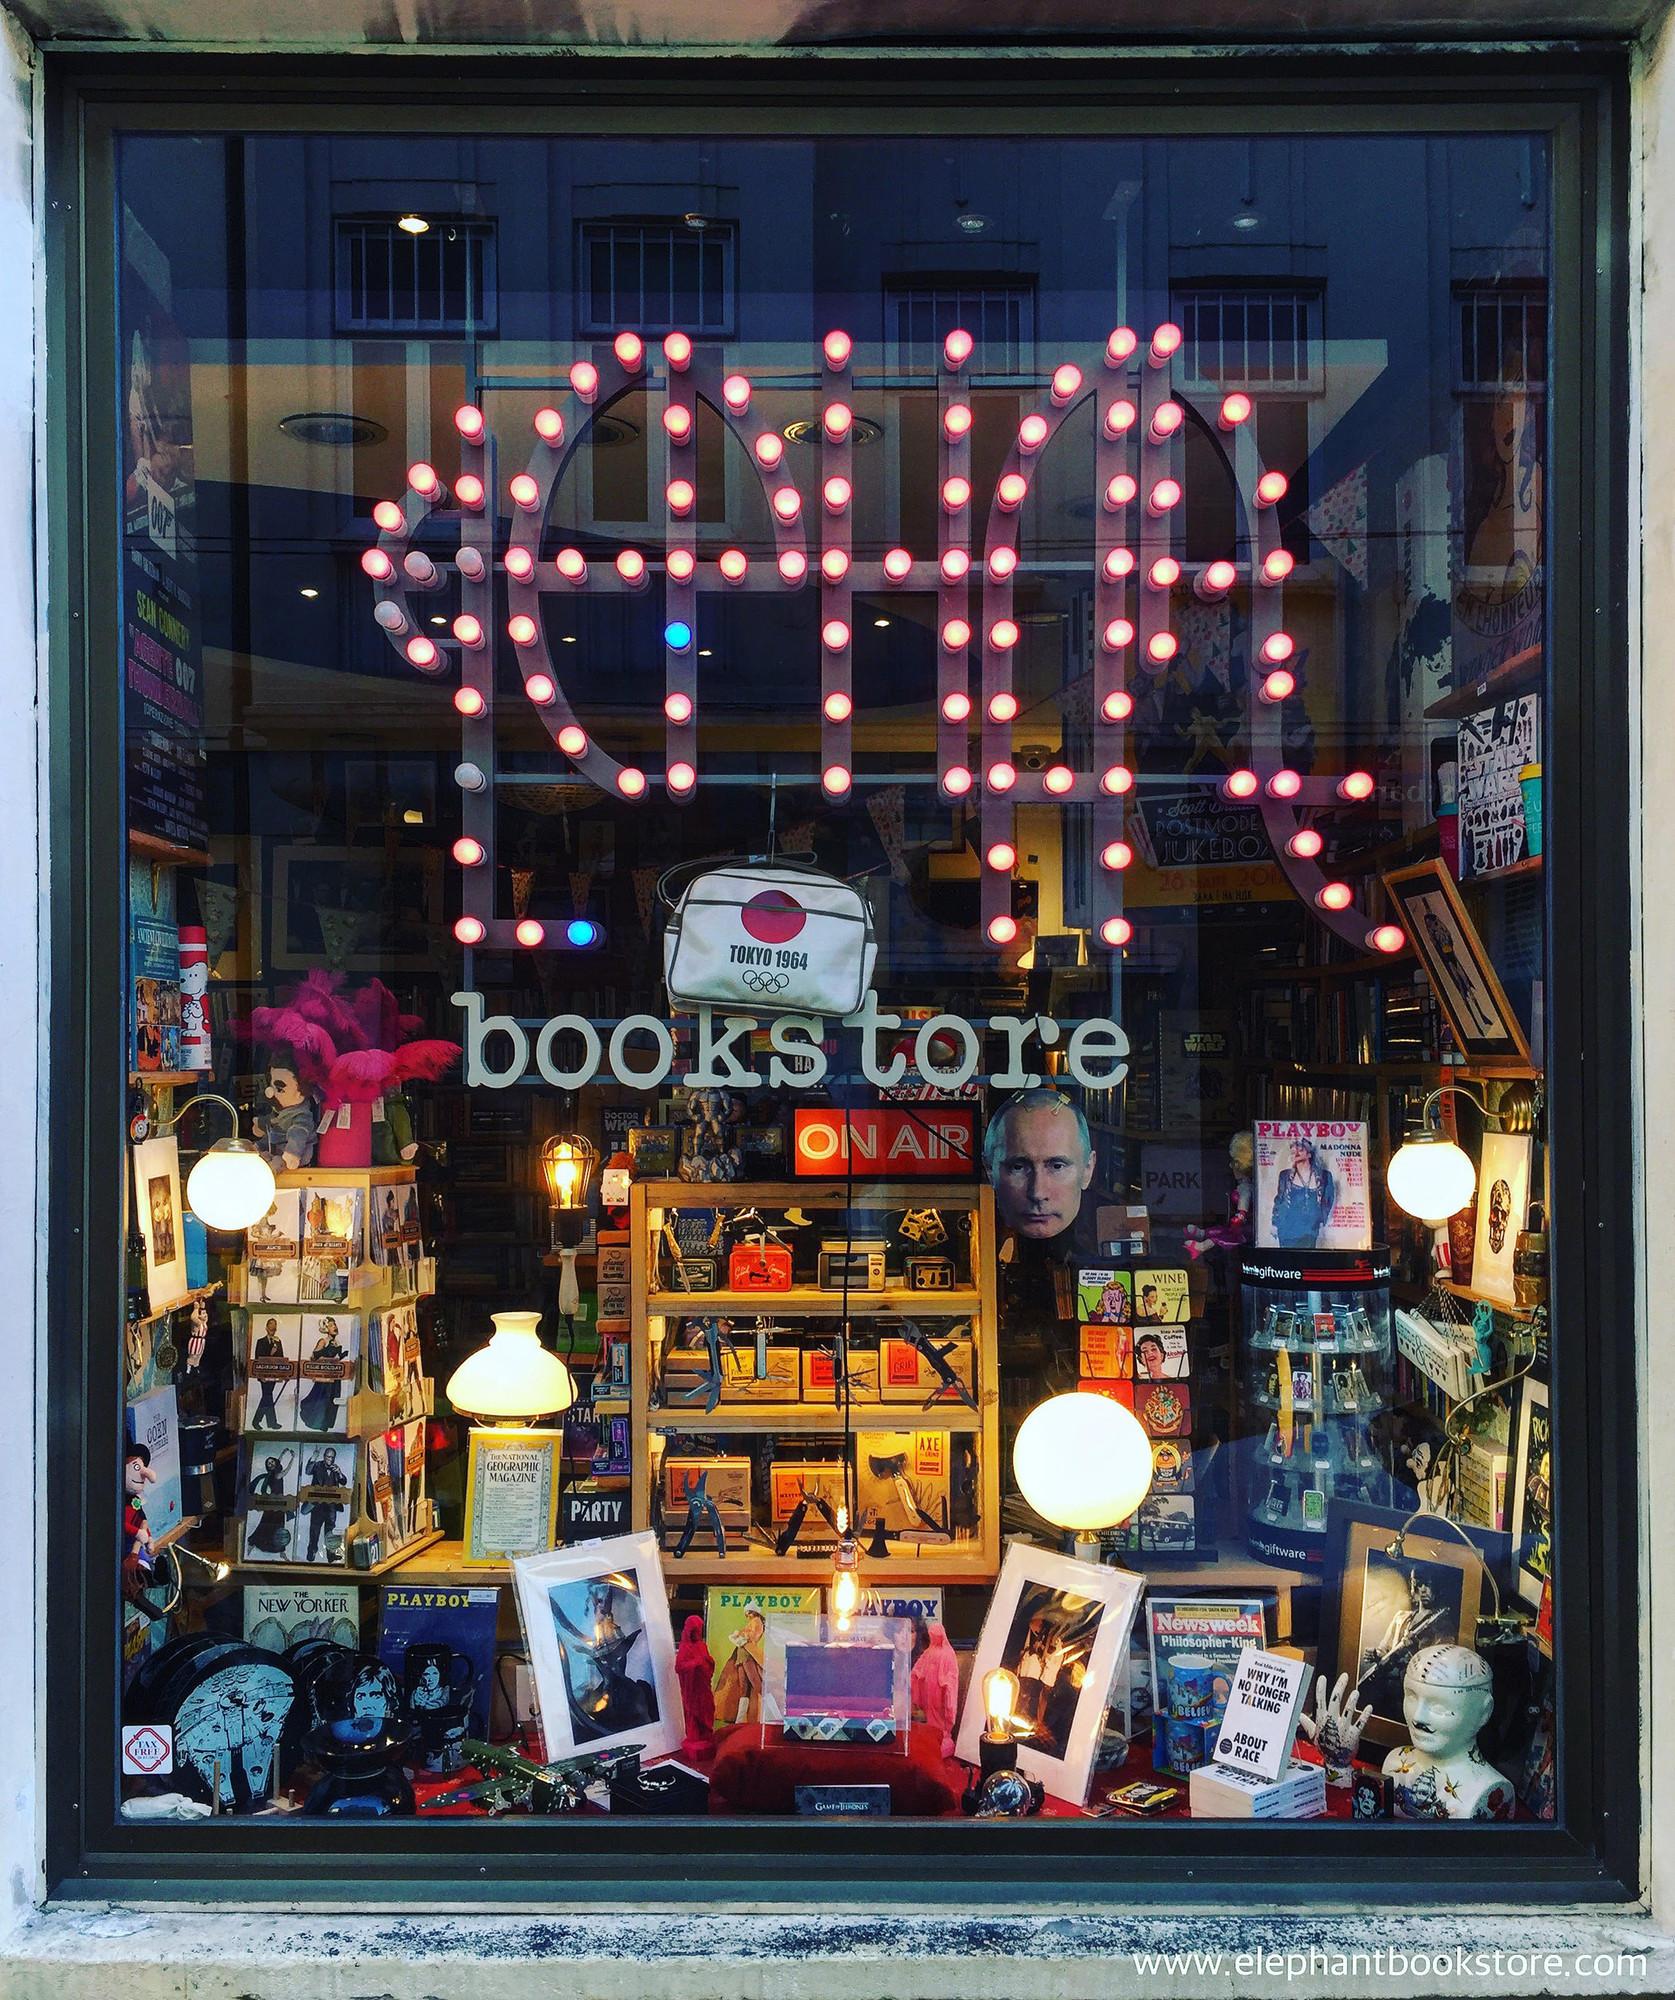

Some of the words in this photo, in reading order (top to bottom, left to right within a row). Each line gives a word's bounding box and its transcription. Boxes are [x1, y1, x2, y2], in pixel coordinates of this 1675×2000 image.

[175, 656, 195, 695] 007
[1156, 814, 1258, 836] POSTMODE
[730, 945, 772, 966] TOKYO
[776, 949, 808, 970] 1964
[452, 990, 1131, 1089] bookstore
[1184, 1034, 1225, 1043] STAR
[1184, 1042, 1225, 1052] WARS
[1258, 1122, 1360, 1137] PLAYBOY
[798, 1123, 877, 1160] ON
[888, 1123, 970, 1160] AIR
[1145, 1171, 1200, 1189] PARK
[1152, 1273, 1186, 1284] WINE!
[919, 1437, 940, 1451] AXE
[502, 1453, 540, 1461] NATIONAL
[486, 1461, 541, 1472] GEOGRAPHIC
[489, 1472, 537, 1483] MAGAZINE
[258, 1599, 289, 1613] NEW
[294, 1599, 349, 1613] YORKER
[387, 1593, 471, 1608] PLAYBOY
[721, 1595, 802, 1608] PLAYBOY
[853, 1600, 938, 1617] AYBOY
[1156, 1613, 1261, 1633] Newsweek
[1161, 1634, 1256, 1650] Philosopher-King
[1247, 1667, 1270, 1684] WHY
[1271, 1675, 1288, 1689] I'M
[1238, 1679, 1252, 1692] NO
[1254, 1683, 1291, 1703] LONGER
[1241, 1693, 1281, 1714] TALKING
[1233, 1732, 1268, 1751] ABOUT
[134, 1748, 160, 1756] FREE
[1234, 1745, 1260, 1763] RACE
[815, 1802, 835, 1811] GAME
